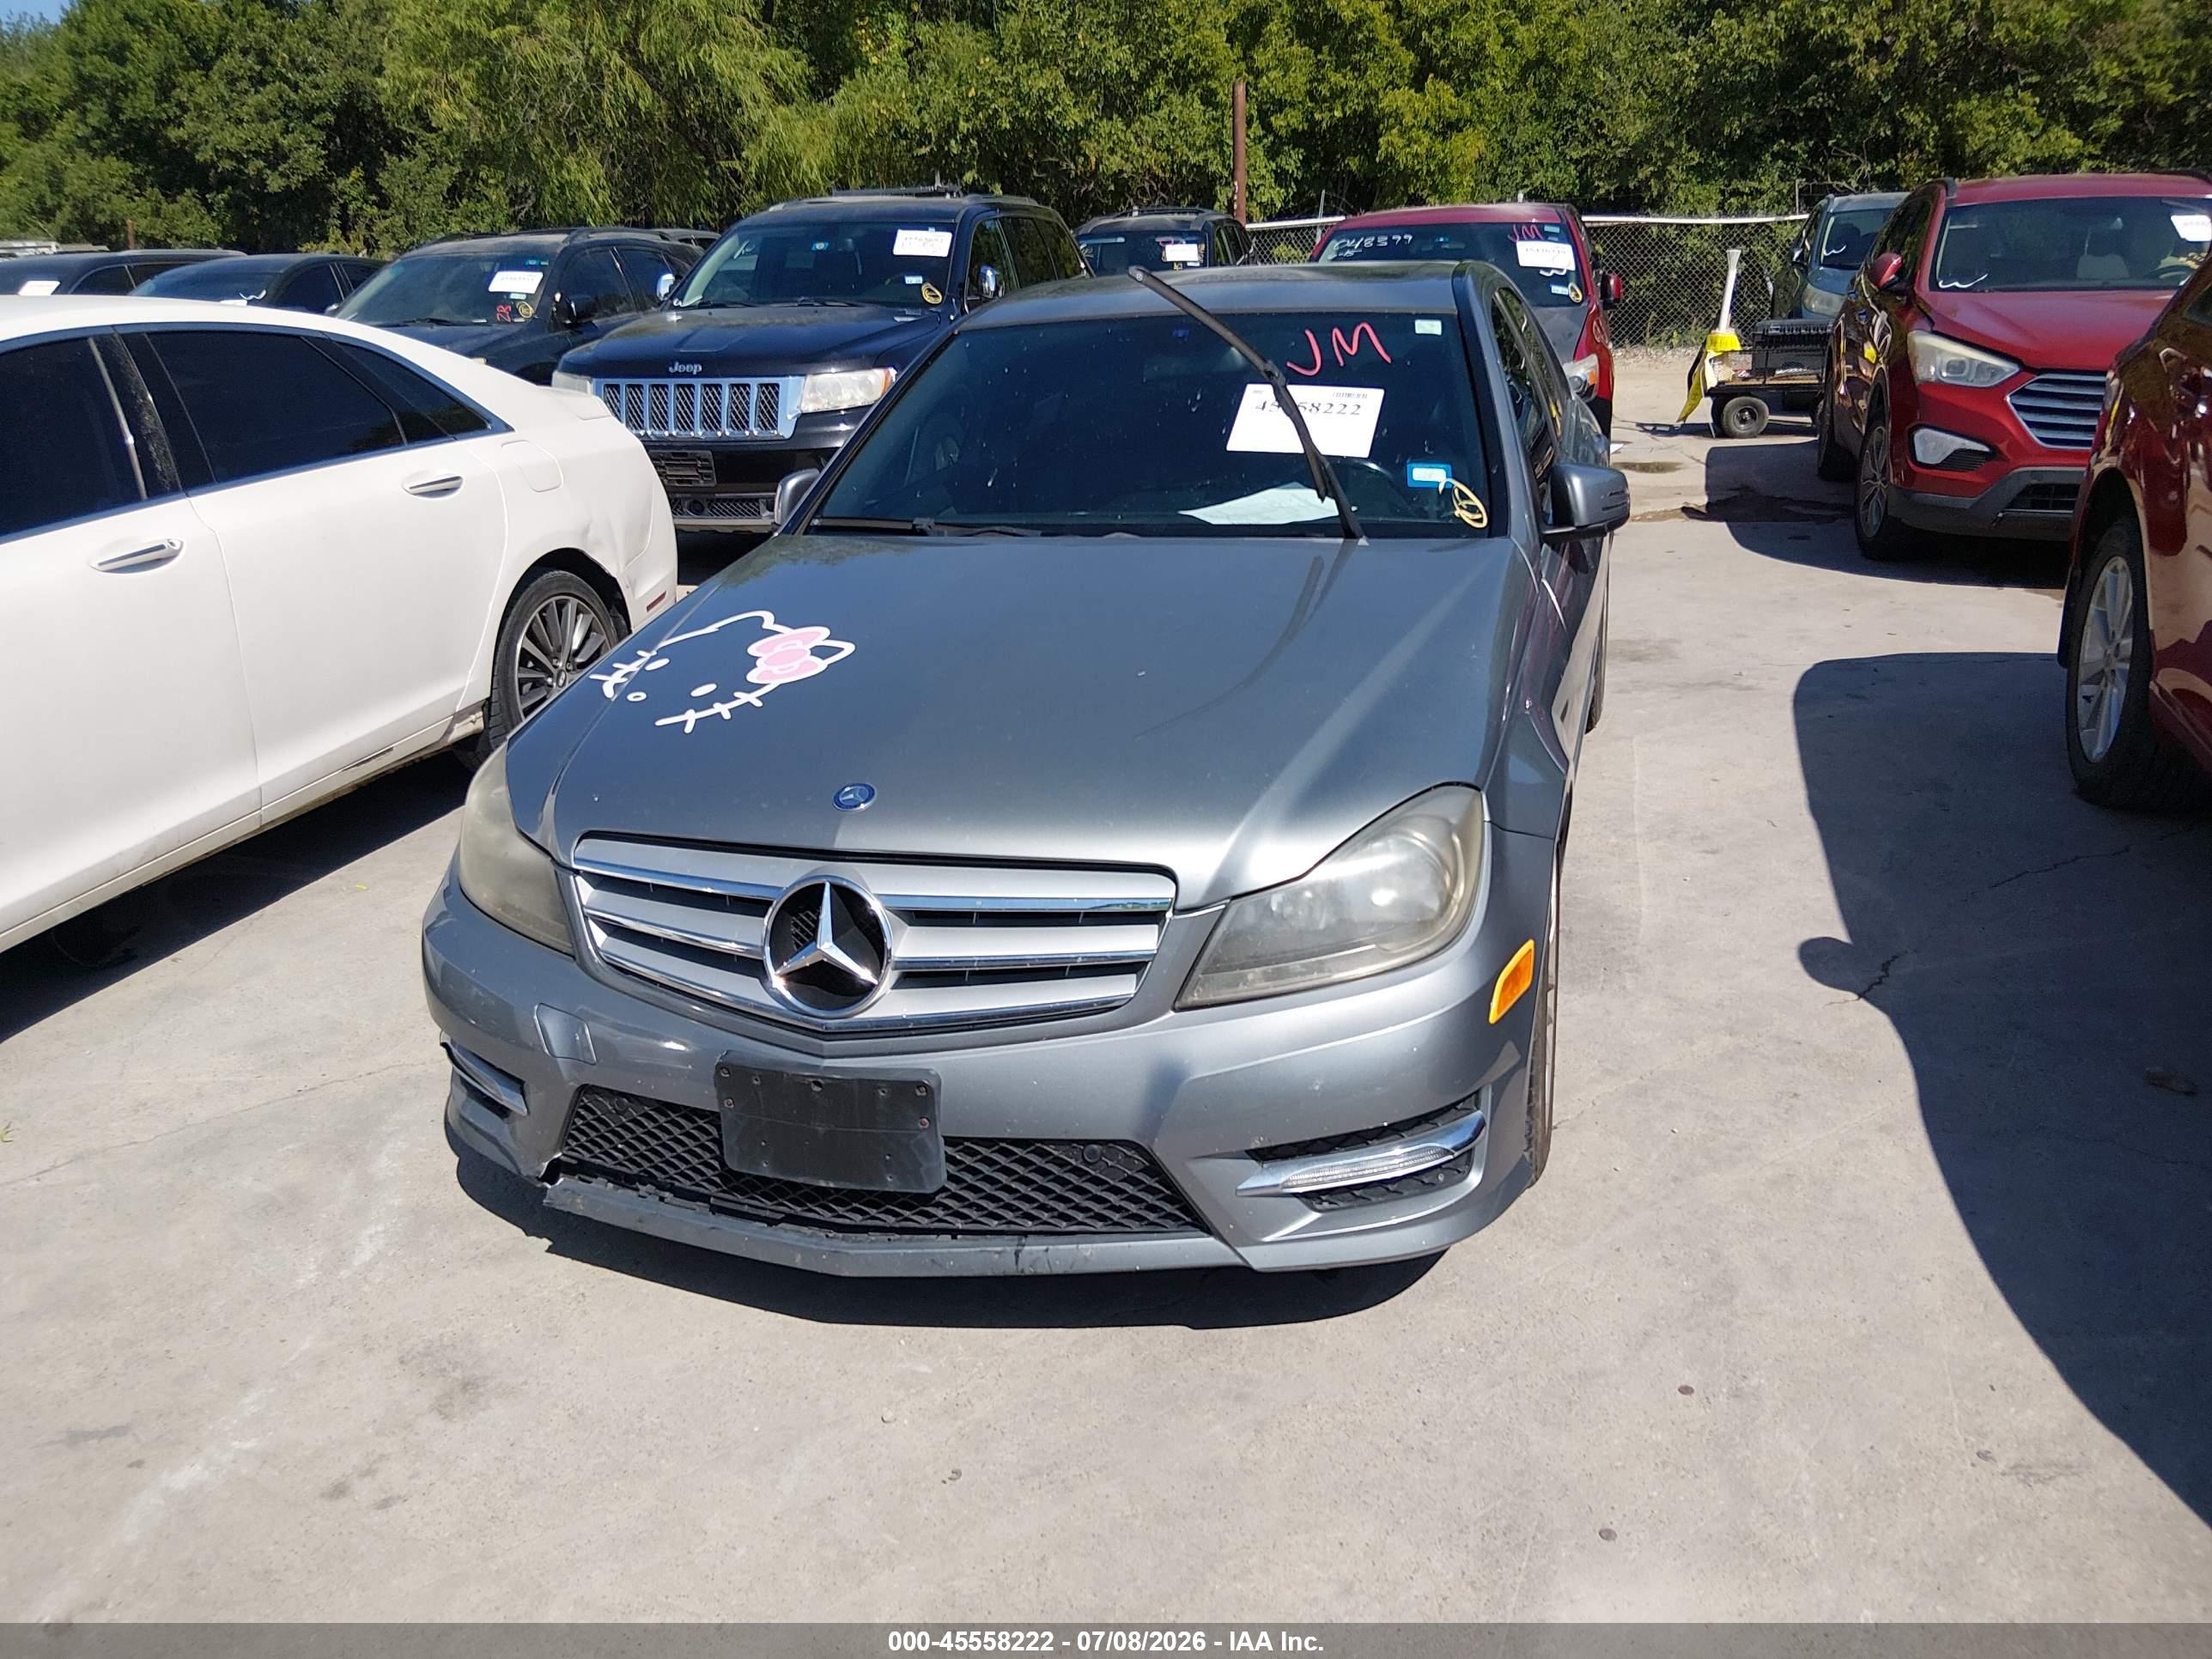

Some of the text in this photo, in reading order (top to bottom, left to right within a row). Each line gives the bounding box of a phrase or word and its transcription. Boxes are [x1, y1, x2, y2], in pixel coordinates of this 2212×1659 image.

[1286, 321, 1393, 377] JM
[668, 361, 702, 375] Jeep
[1255, 399, 1362, 416] 4558222
